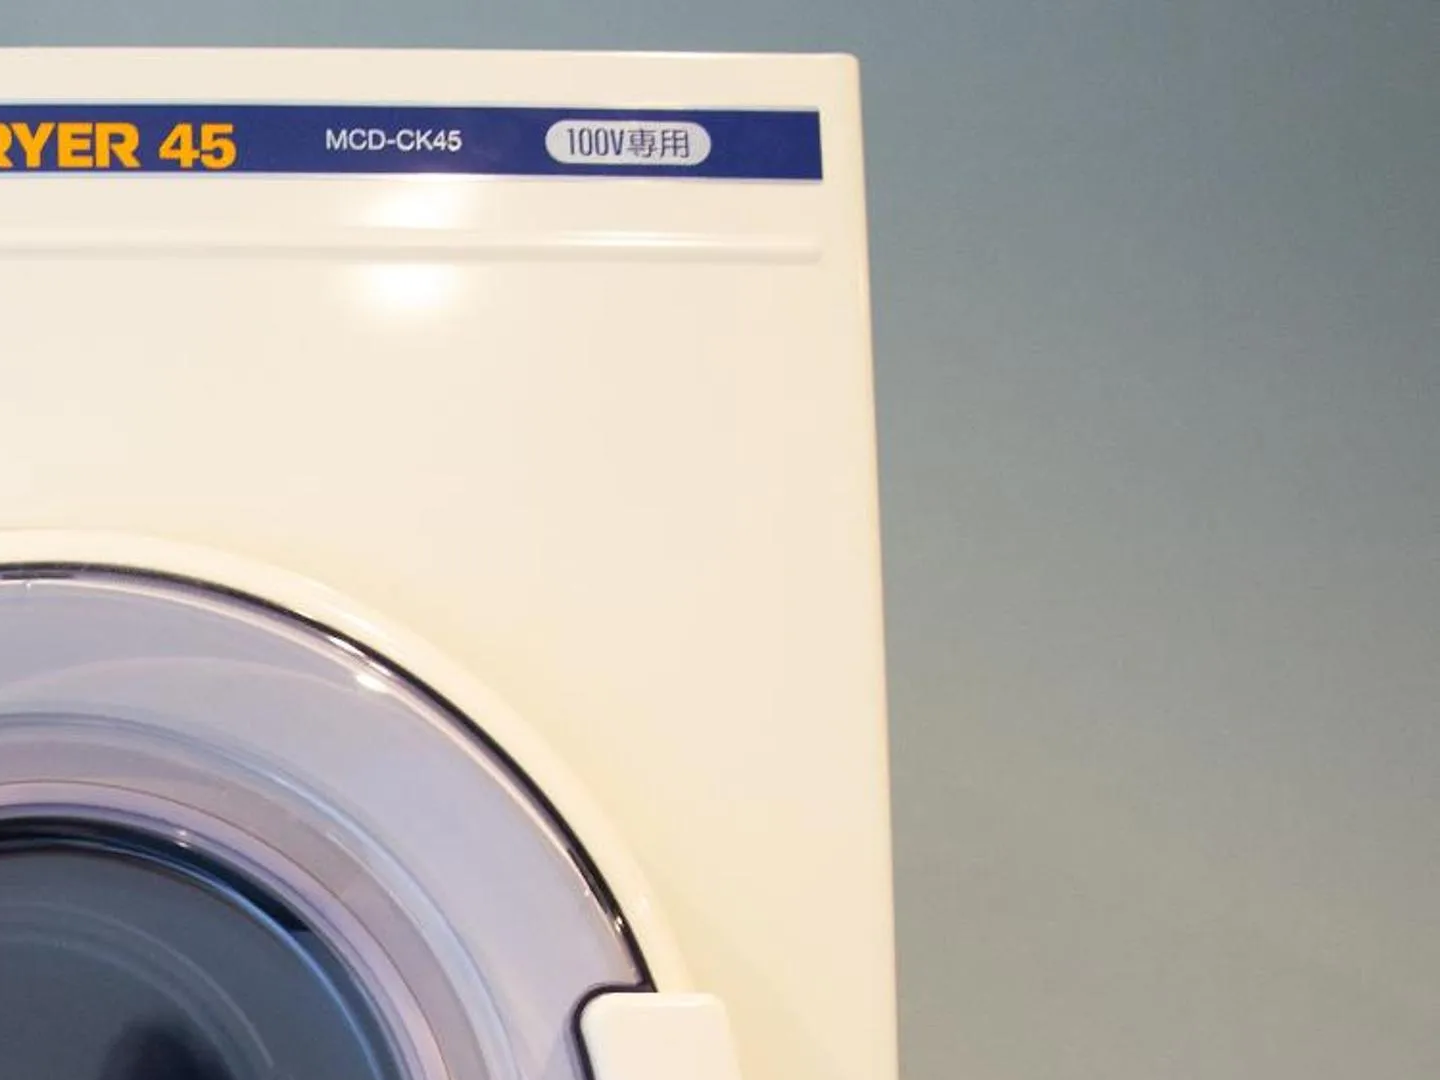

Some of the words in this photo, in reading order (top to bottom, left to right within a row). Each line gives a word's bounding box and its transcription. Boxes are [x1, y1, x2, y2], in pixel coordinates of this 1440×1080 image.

[159, 122, 236, 169] 45
[325, 129, 463, 153] MCD-CK45
[565, 126, 691, 159] 100V専用
